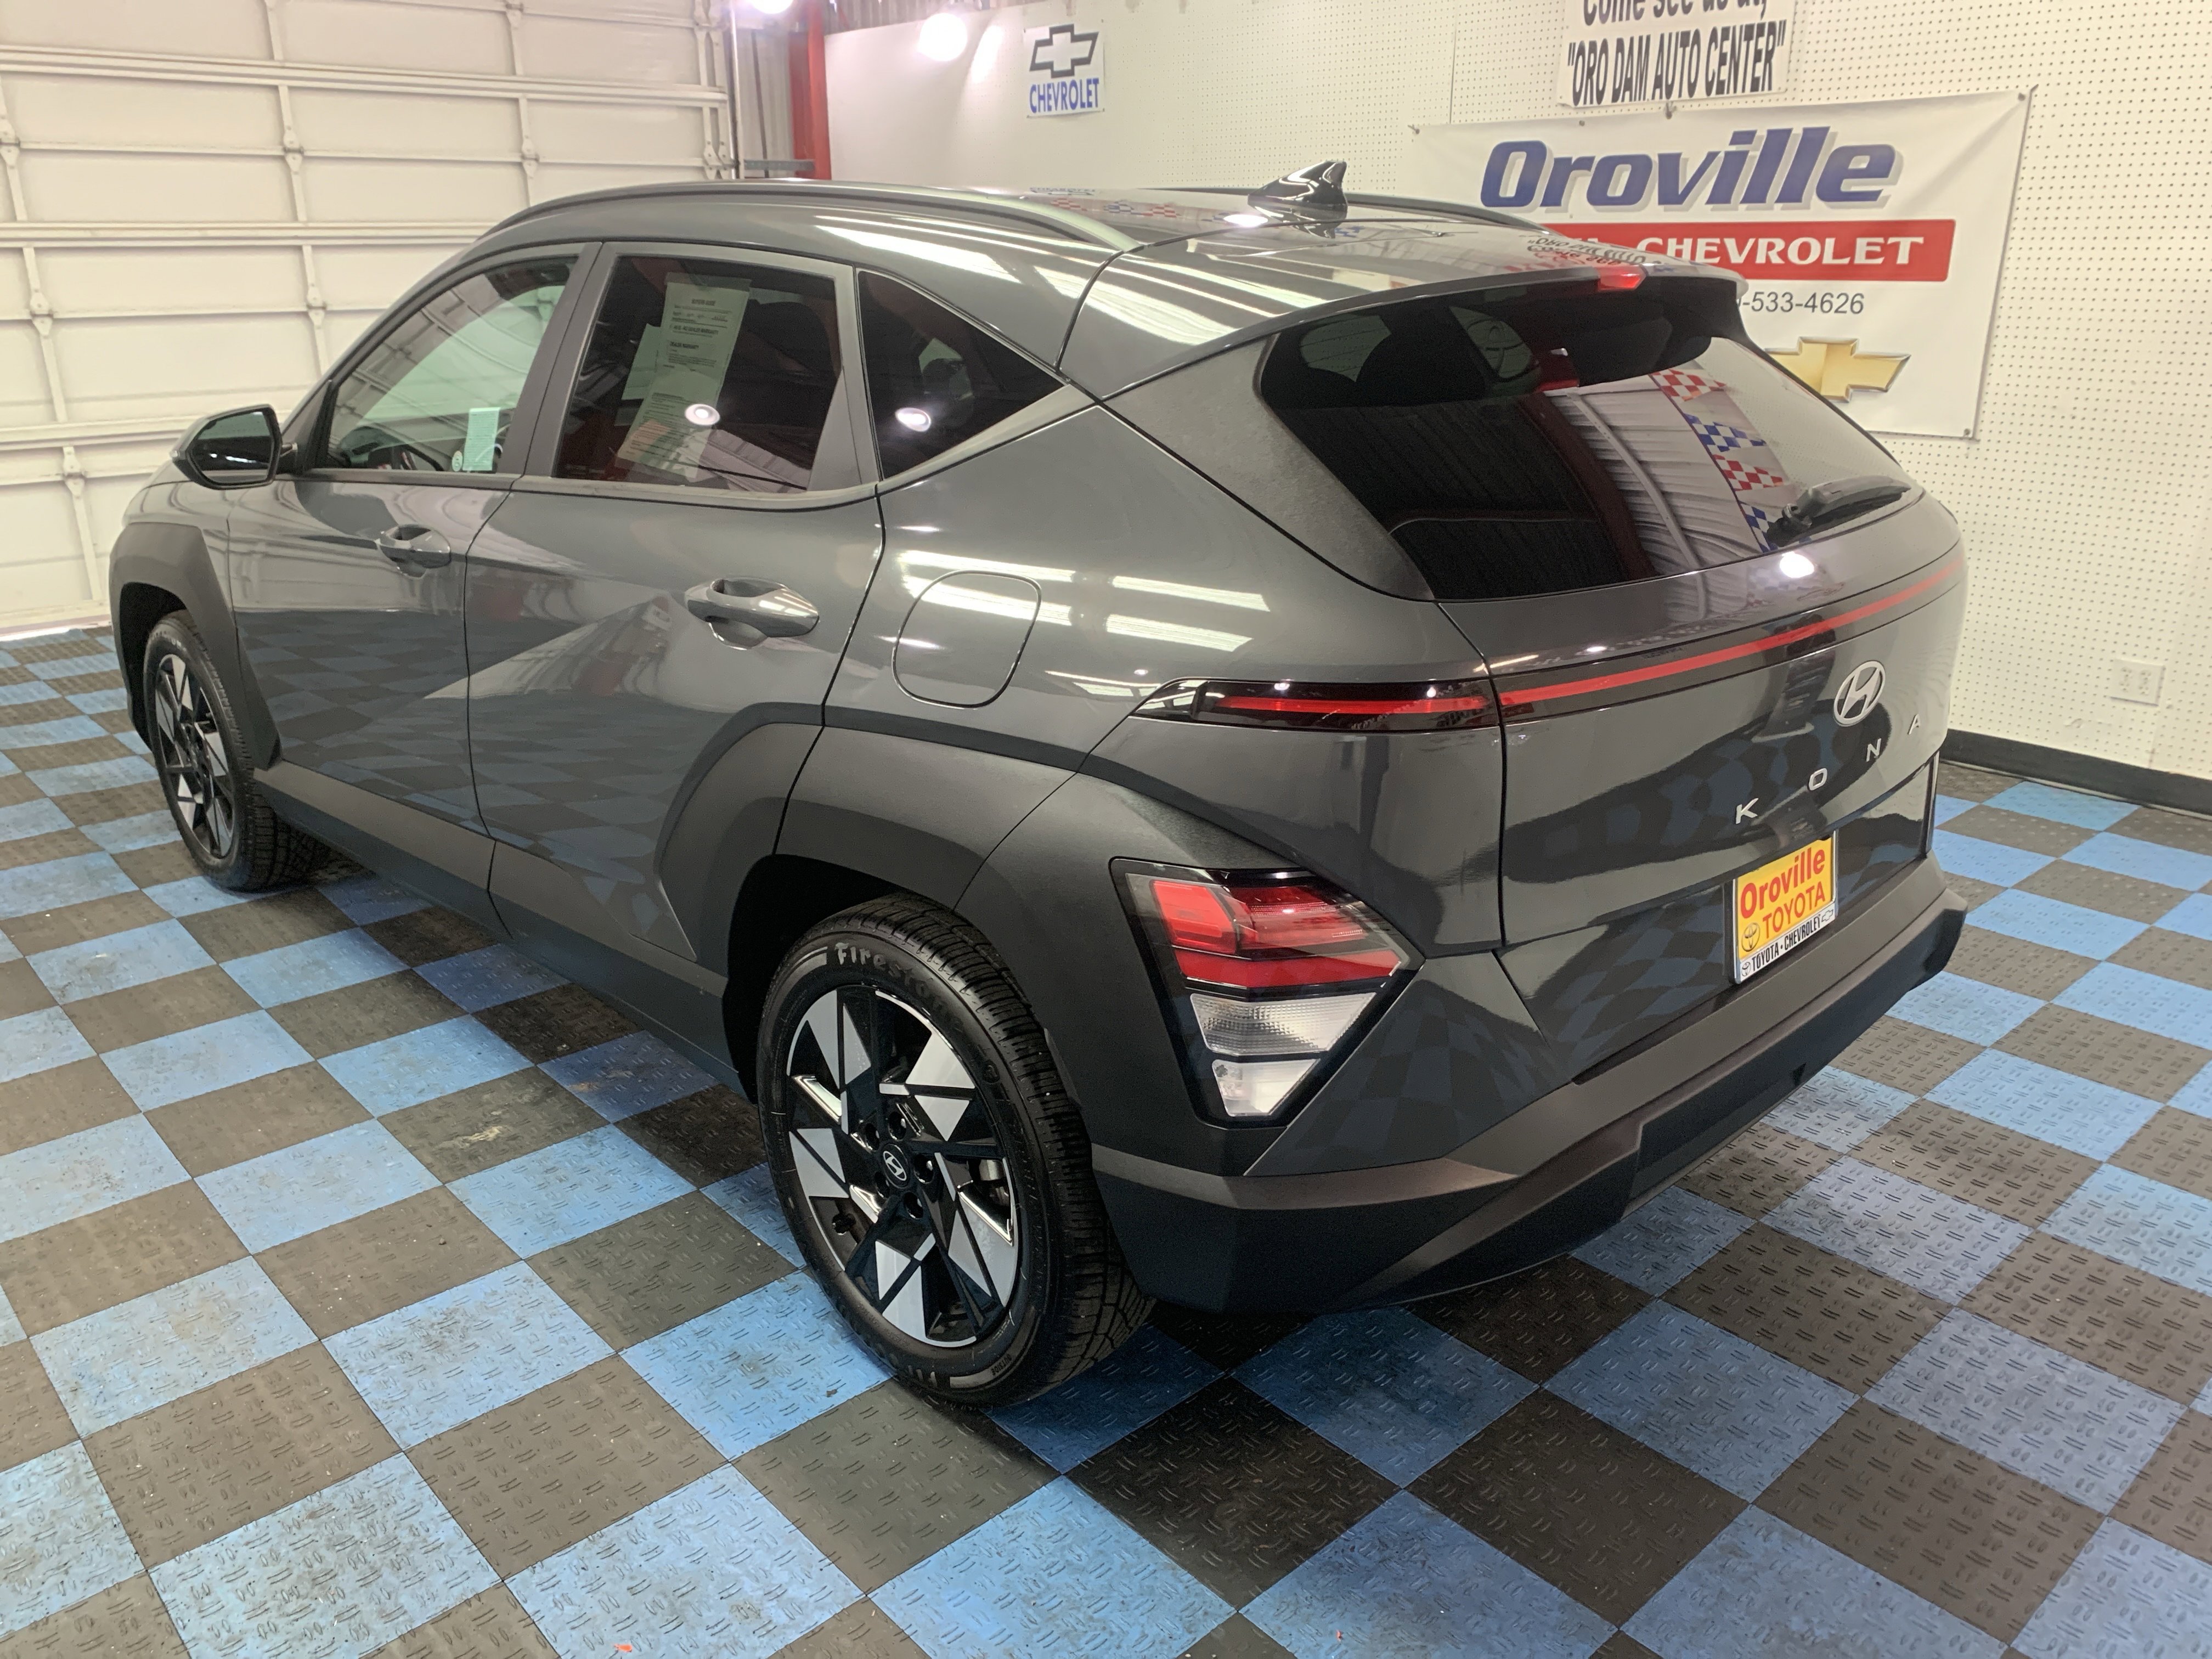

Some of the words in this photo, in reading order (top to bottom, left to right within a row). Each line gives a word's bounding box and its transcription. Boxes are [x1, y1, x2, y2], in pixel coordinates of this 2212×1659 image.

[1568, 38, 1609, 106] "ORO
[1611, 34, 1651, 103] DAM
[1651, 29, 1701, 100] AUTO
[1706, 19, 1787, 97] CENTER"
[1029, 77, 1099, 114] CHEVROLET
[1481, 126, 1897, 208] Oroville
[1737, 291, 1865, 314] -533-4626
[1740, 847, 1826, 919] Oroville
[1762, 881, 1826, 939] TOYOTA
[1752, 942, 1779, 972] TOYOTA
[1784, 916, 1820, 951] CHEVROLET
